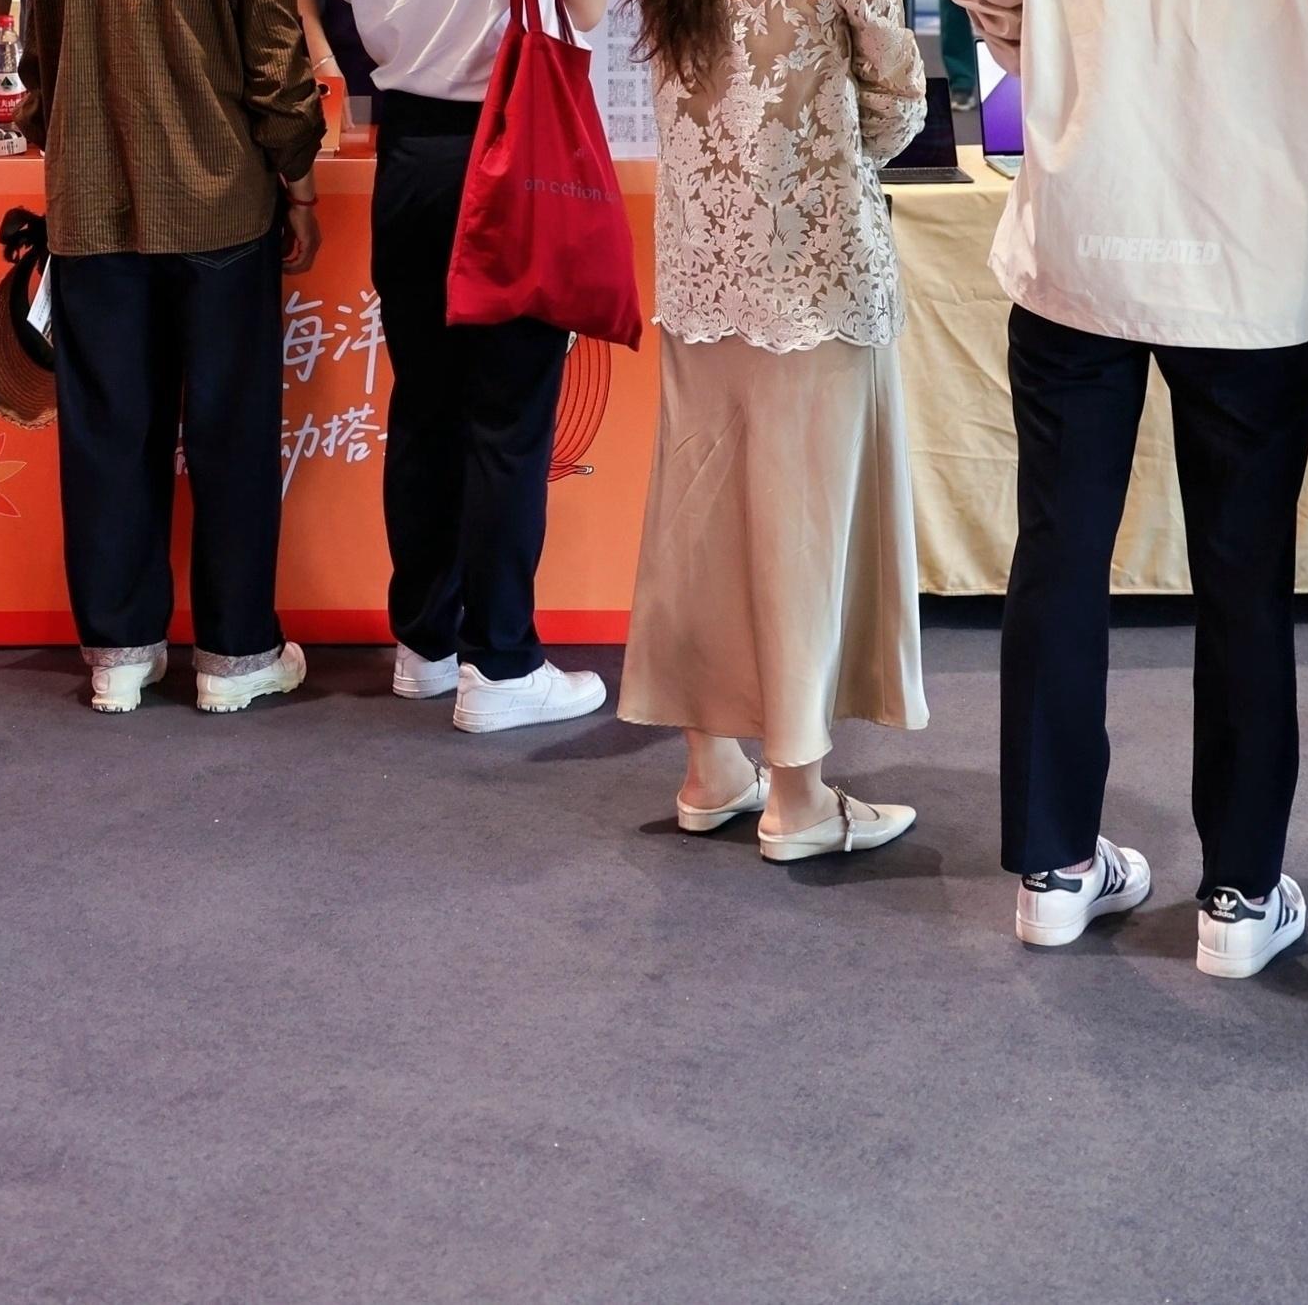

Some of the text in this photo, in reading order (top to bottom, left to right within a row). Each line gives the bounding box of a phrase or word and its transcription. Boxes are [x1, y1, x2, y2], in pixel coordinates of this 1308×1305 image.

[1077, 234, 1222, 265] UNDEFEATED
[1025, 879, 1047, 889] adidas
[1212, 909, 1236, 919] adidas
